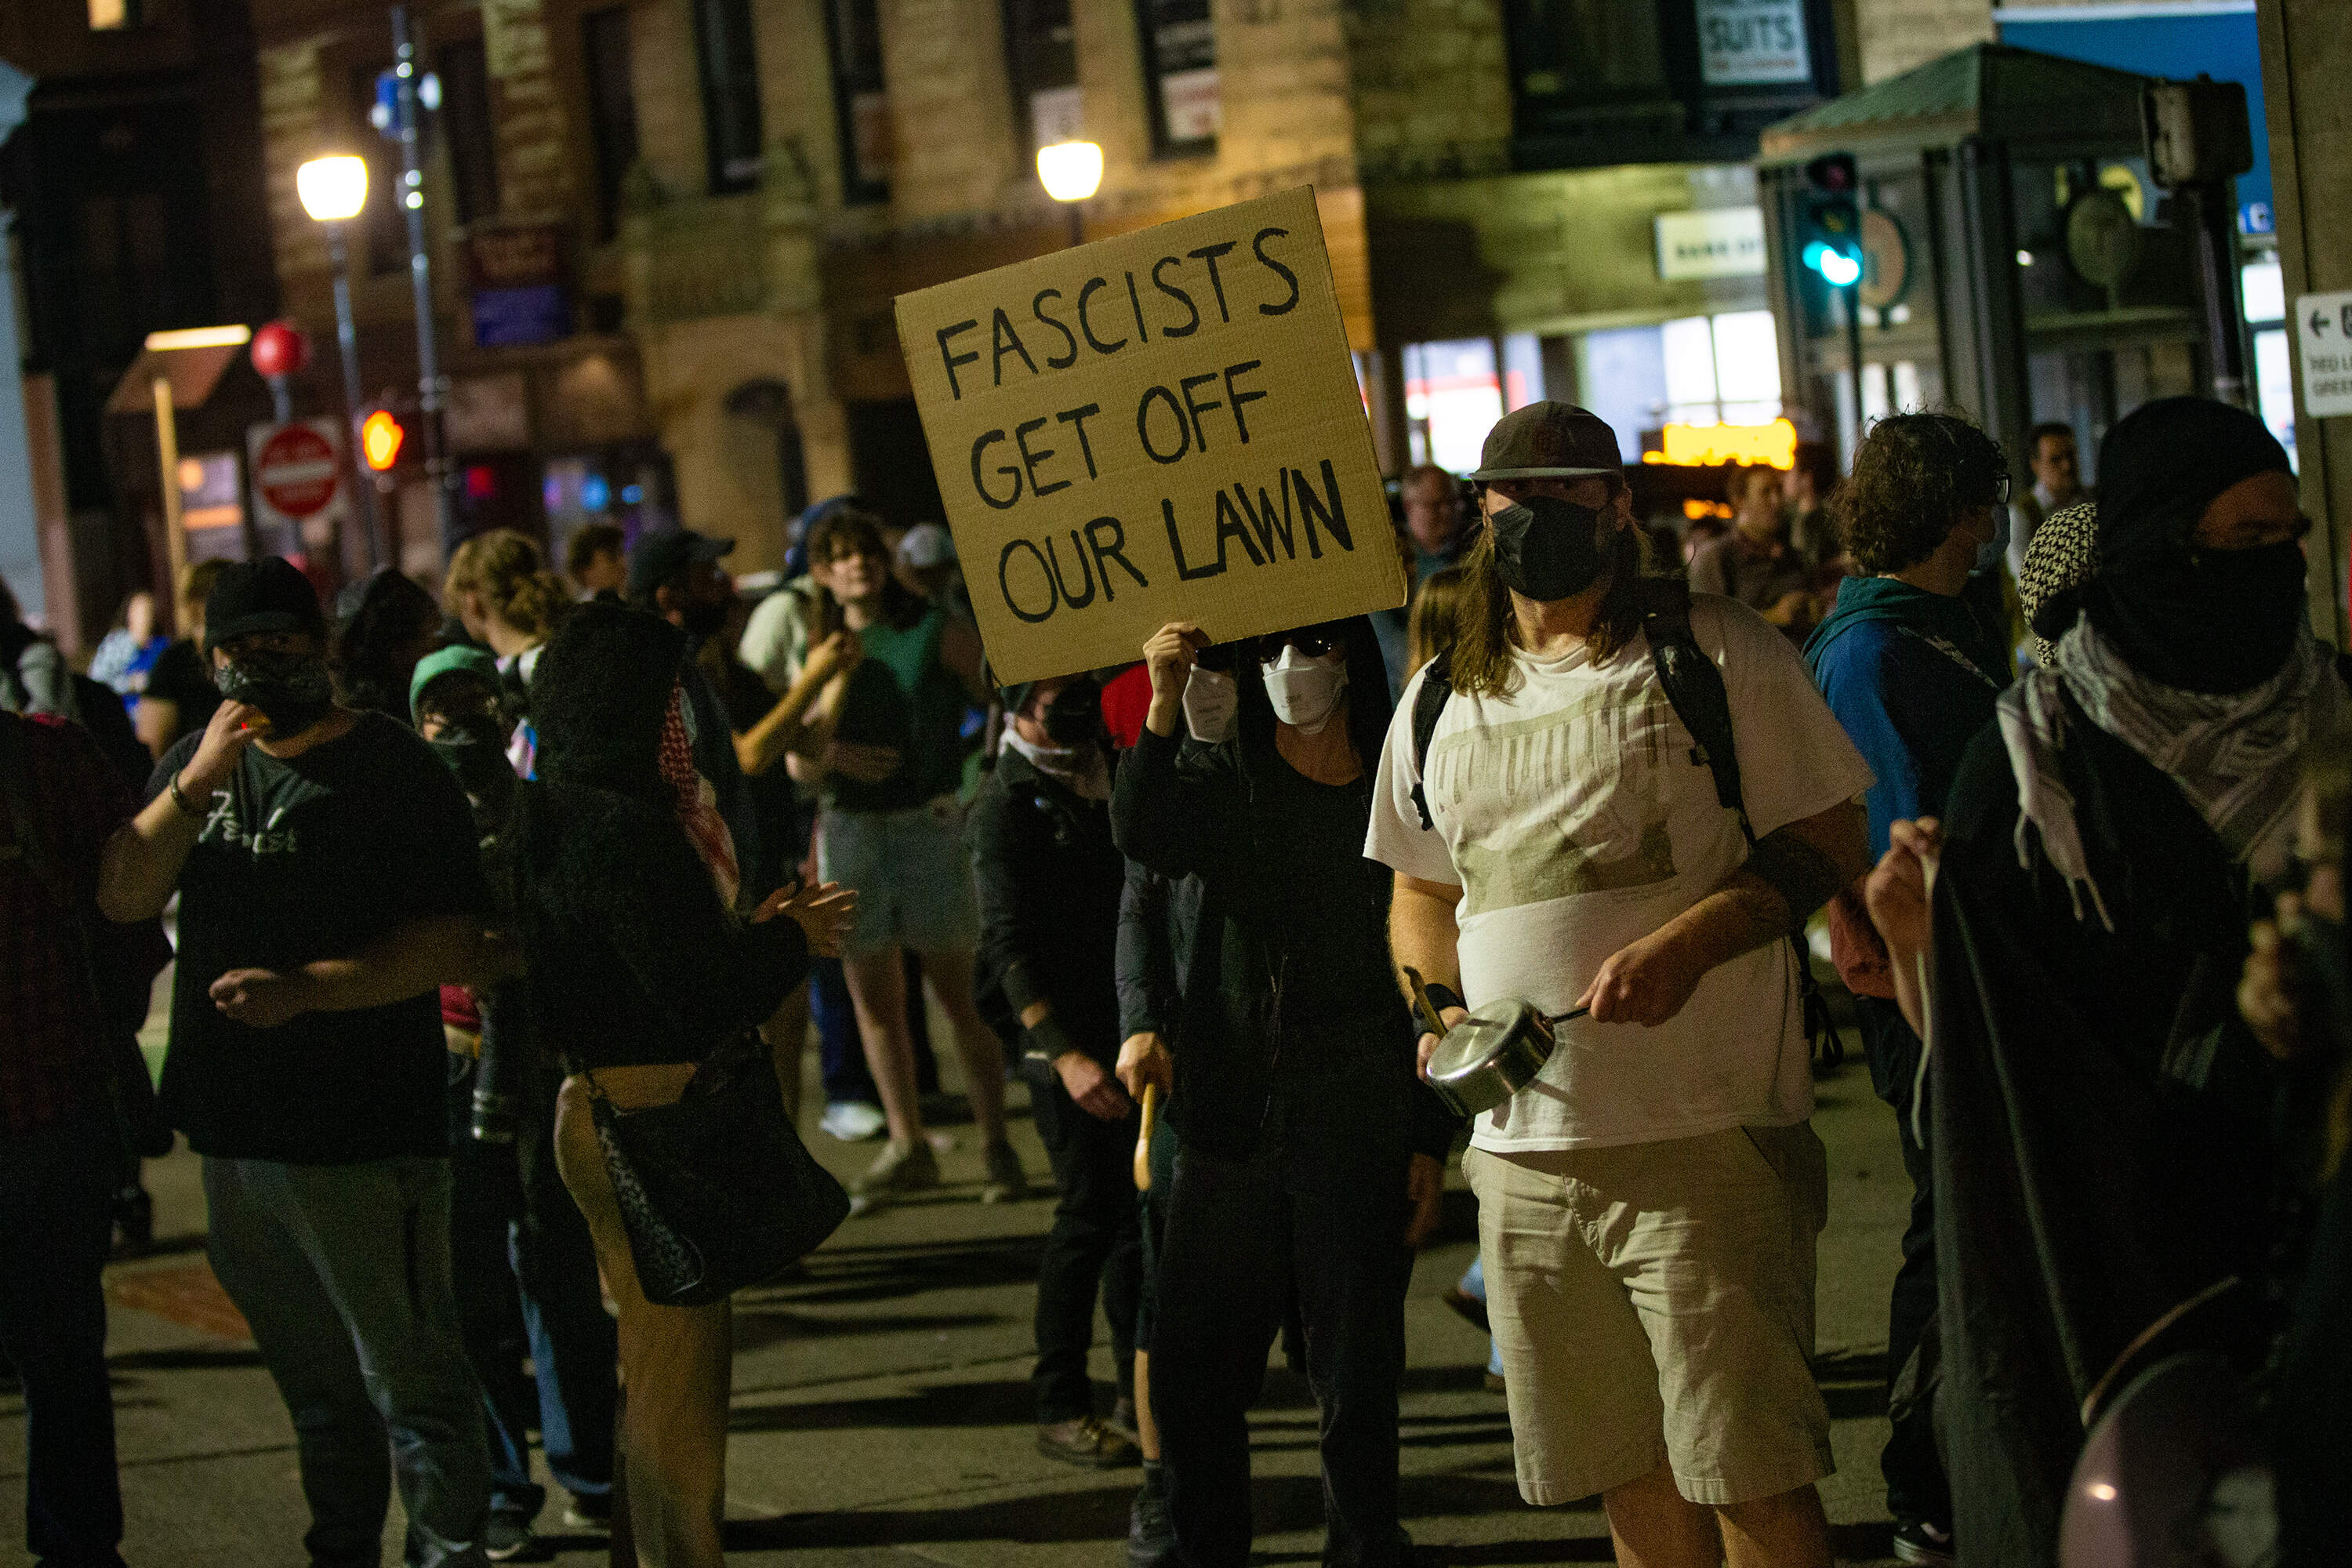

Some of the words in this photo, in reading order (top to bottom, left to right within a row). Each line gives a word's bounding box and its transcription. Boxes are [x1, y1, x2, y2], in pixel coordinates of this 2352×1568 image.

[1706, 15, 1796, 53] SUITS
[936, 227, 1299, 400] FASCISTS
[1675, 240, 1728, 259] BANK
[971, 402, 1100, 510] GET
[1136, 359, 1268, 465] OFF
[998, 516, 1149, 624] OUR
[1160, 458, 1355, 582] LAWN
